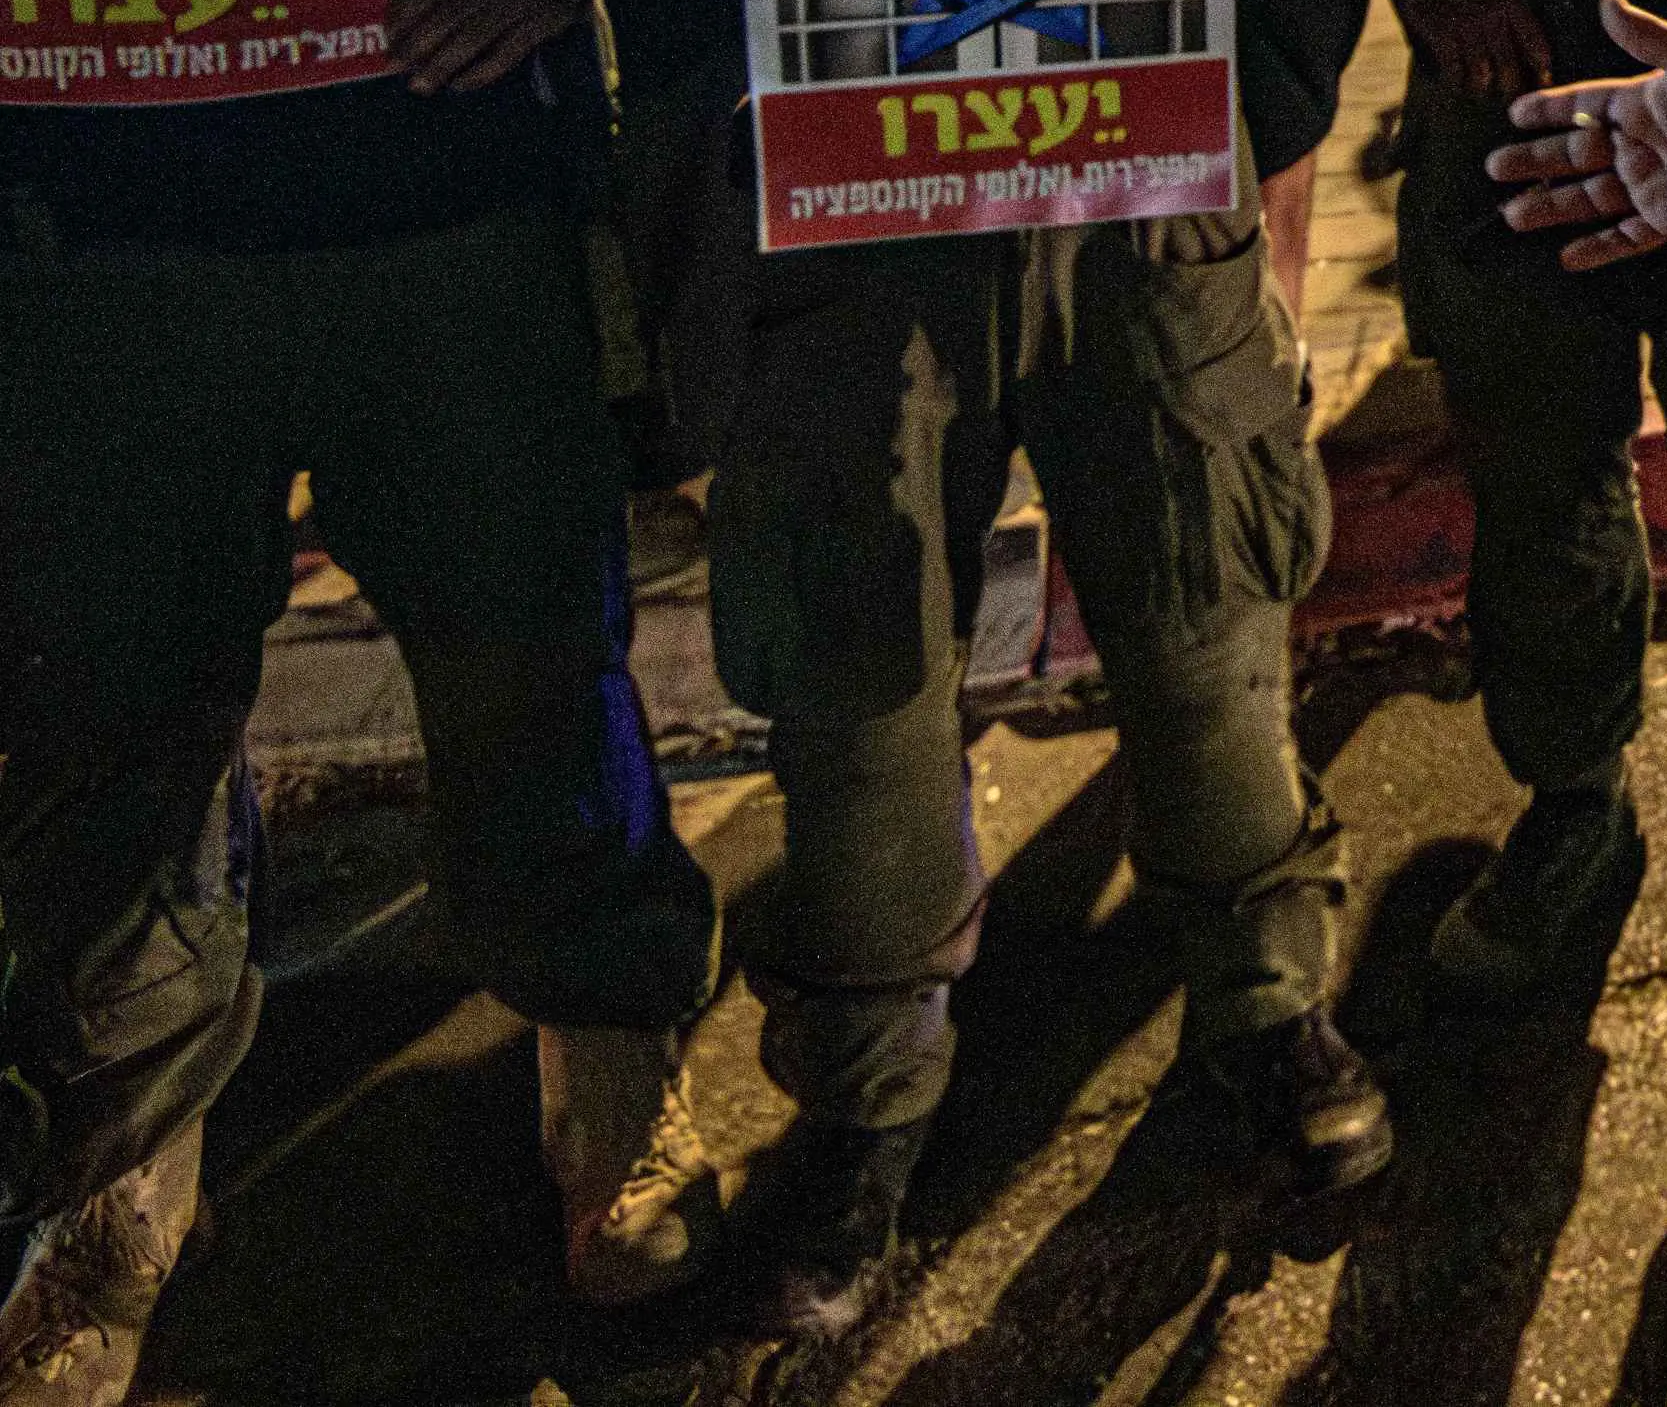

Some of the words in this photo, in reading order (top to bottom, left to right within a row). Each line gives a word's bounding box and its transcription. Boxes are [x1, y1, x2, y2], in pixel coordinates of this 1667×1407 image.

[0, 45, 107, 92] הקונס
[116, 36, 228, 79] ואלופי
[789, 173, 966, 220] הקונספציה
